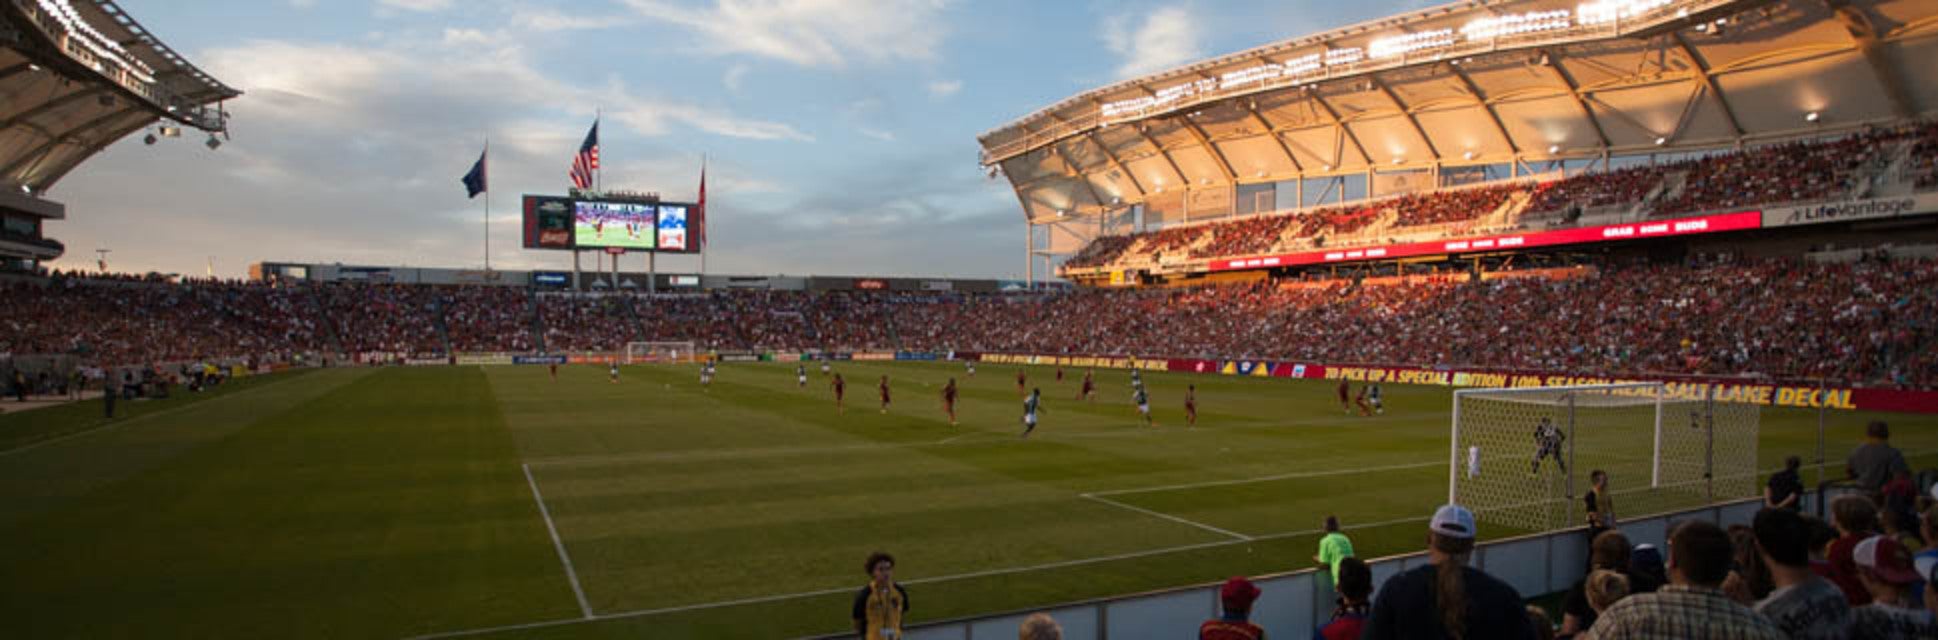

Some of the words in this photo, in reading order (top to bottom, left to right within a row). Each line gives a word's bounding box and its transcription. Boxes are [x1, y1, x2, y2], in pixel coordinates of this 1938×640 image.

[1804, 199, 1915, 220] LifeVantage
[1398, 369, 1449, 385] SPECIAL
[1664, 381, 1709, 400] SALT
[1712, 383, 1774, 405] LAKE
[1775, 386, 1857, 409] DECAL
